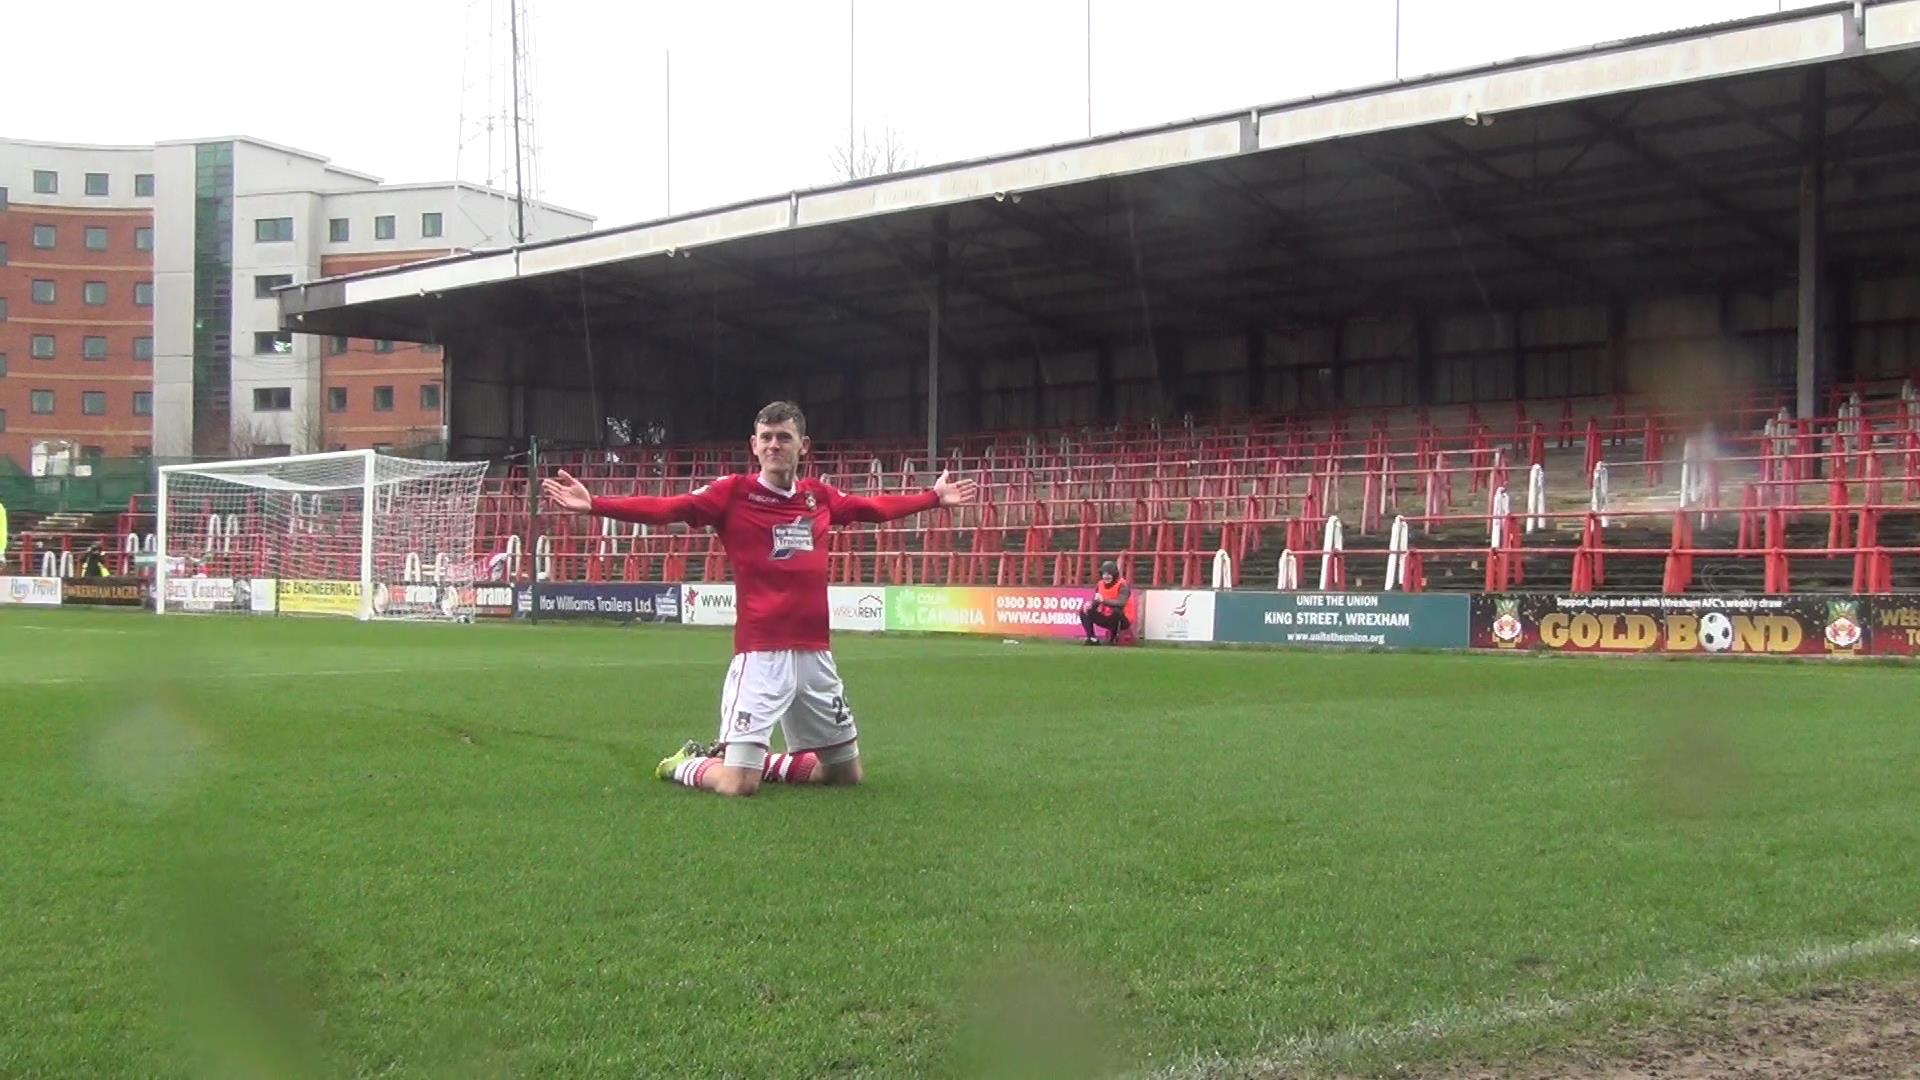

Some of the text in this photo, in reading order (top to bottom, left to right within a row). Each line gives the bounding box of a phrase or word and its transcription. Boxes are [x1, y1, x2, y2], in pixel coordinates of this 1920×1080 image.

[556, 595, 595, 611] Williams
[597, 596, 632, 612] Trailers
[1296, 595, 1378, 607] UNITE THE UNION
[917, 606, 985, 625] CAMBRIA
[1264, 612, 1410, 627] KING STREET, WREXHAM
[1540, 612, 1658, 649] GOLD
